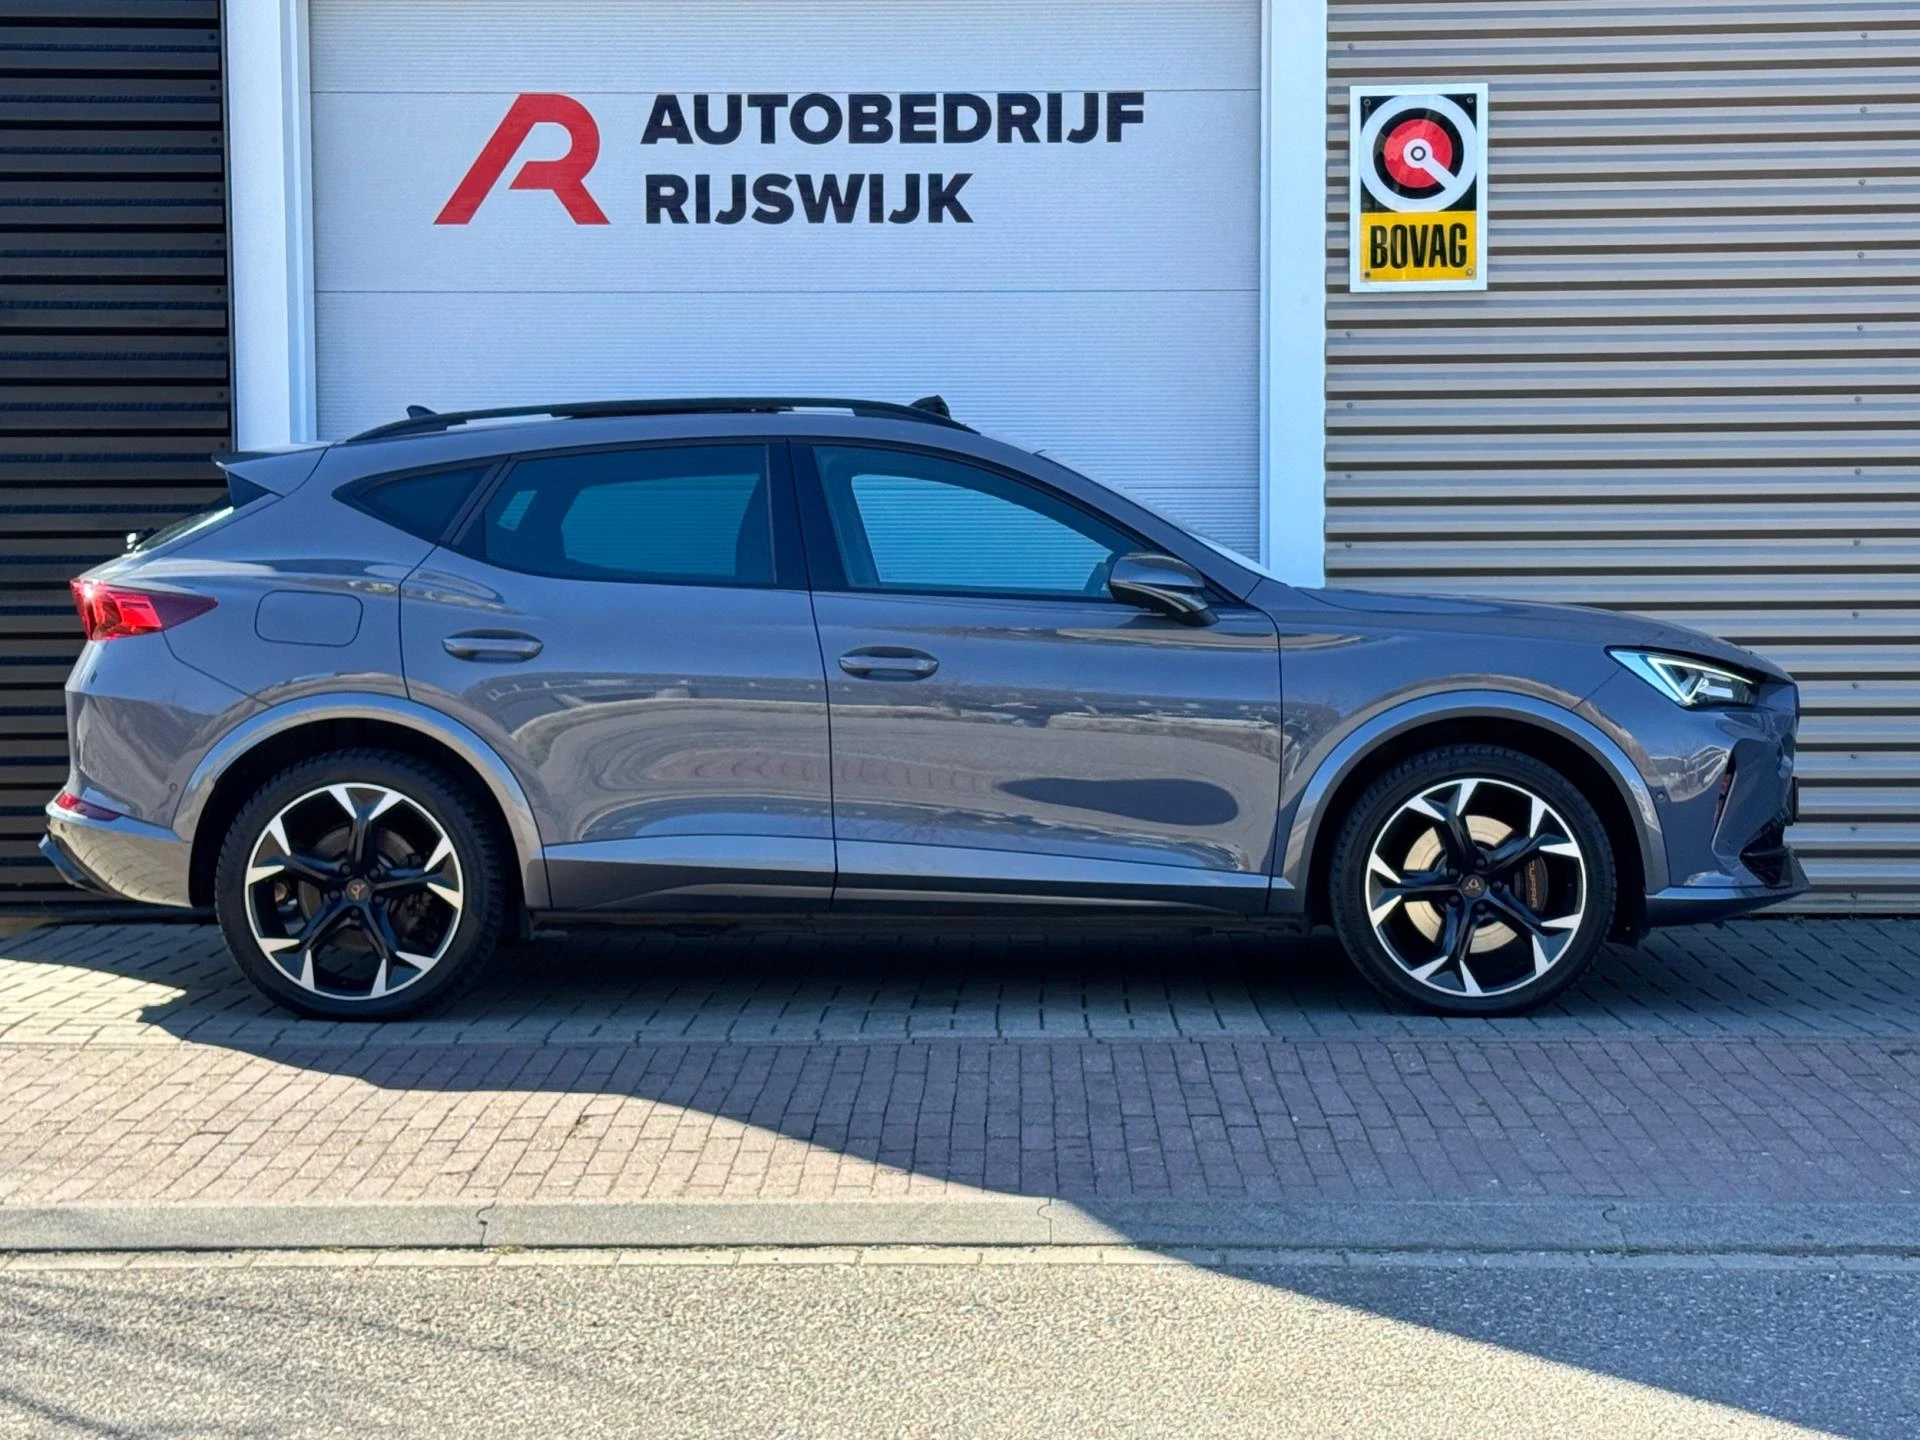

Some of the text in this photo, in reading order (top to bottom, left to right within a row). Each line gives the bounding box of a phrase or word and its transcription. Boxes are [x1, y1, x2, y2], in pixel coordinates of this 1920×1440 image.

[640, 92, 1145, 145] AUTOBEDRIJF
[645, 173, 974, 225] RIJSWIJK
[1369, 222, 1468, 269] BOVAG
